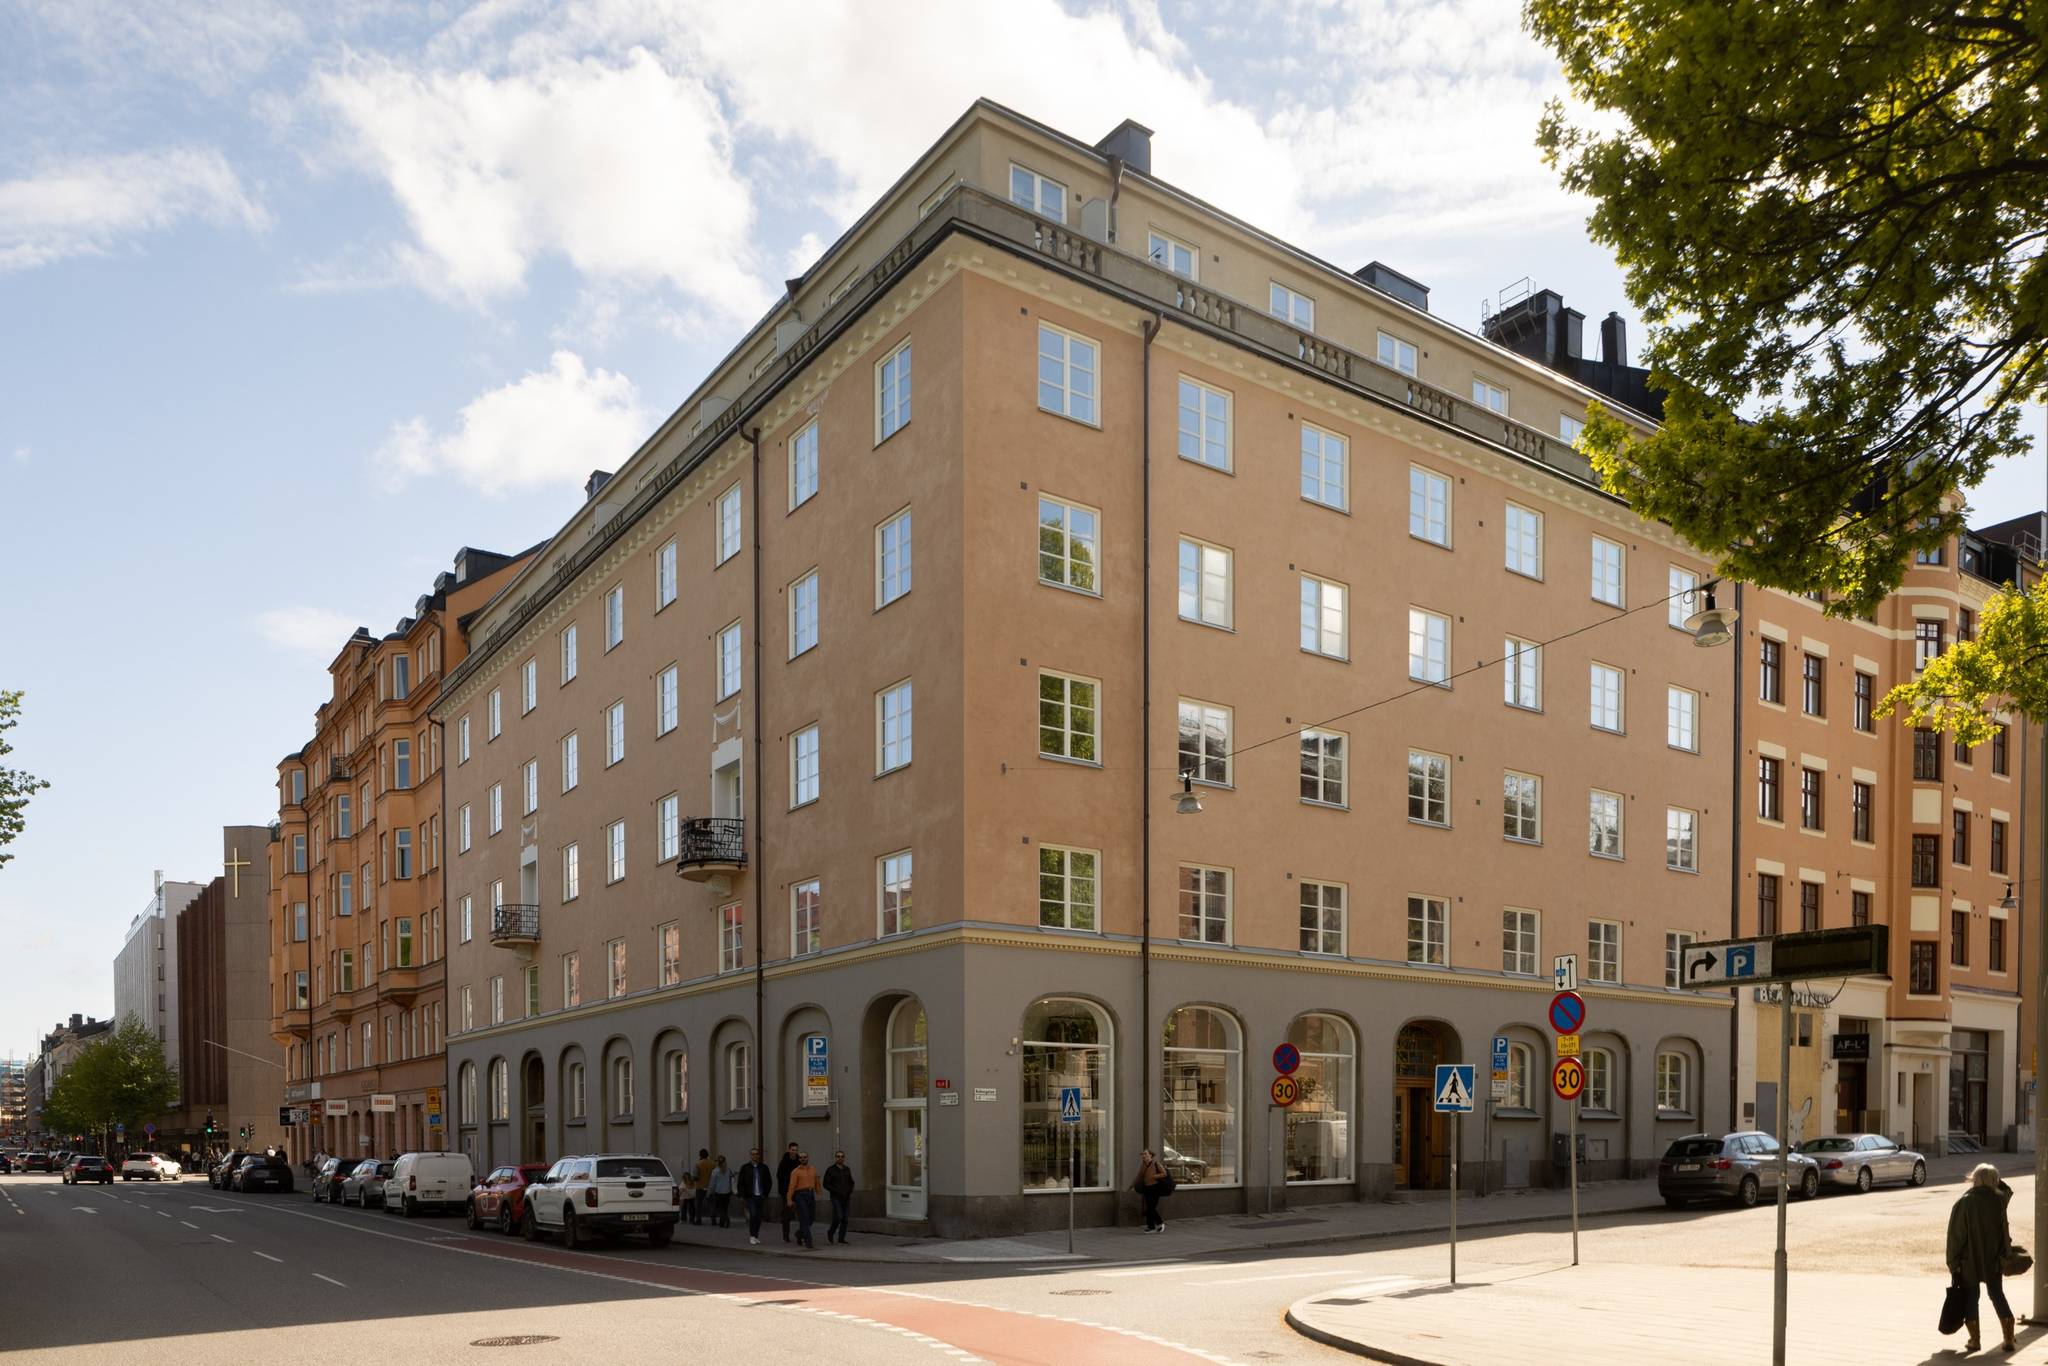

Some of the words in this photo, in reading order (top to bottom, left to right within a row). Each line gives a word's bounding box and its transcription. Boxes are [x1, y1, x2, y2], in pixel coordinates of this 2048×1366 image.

[1734, 955, 1747, 976] P
[812, 1039, 824, 1054] P
[1497, 1039, 1506, 1052] P
[1558, 1069, 1579, 1088] 30
[1276, 1083, 1294, 1099] 30
